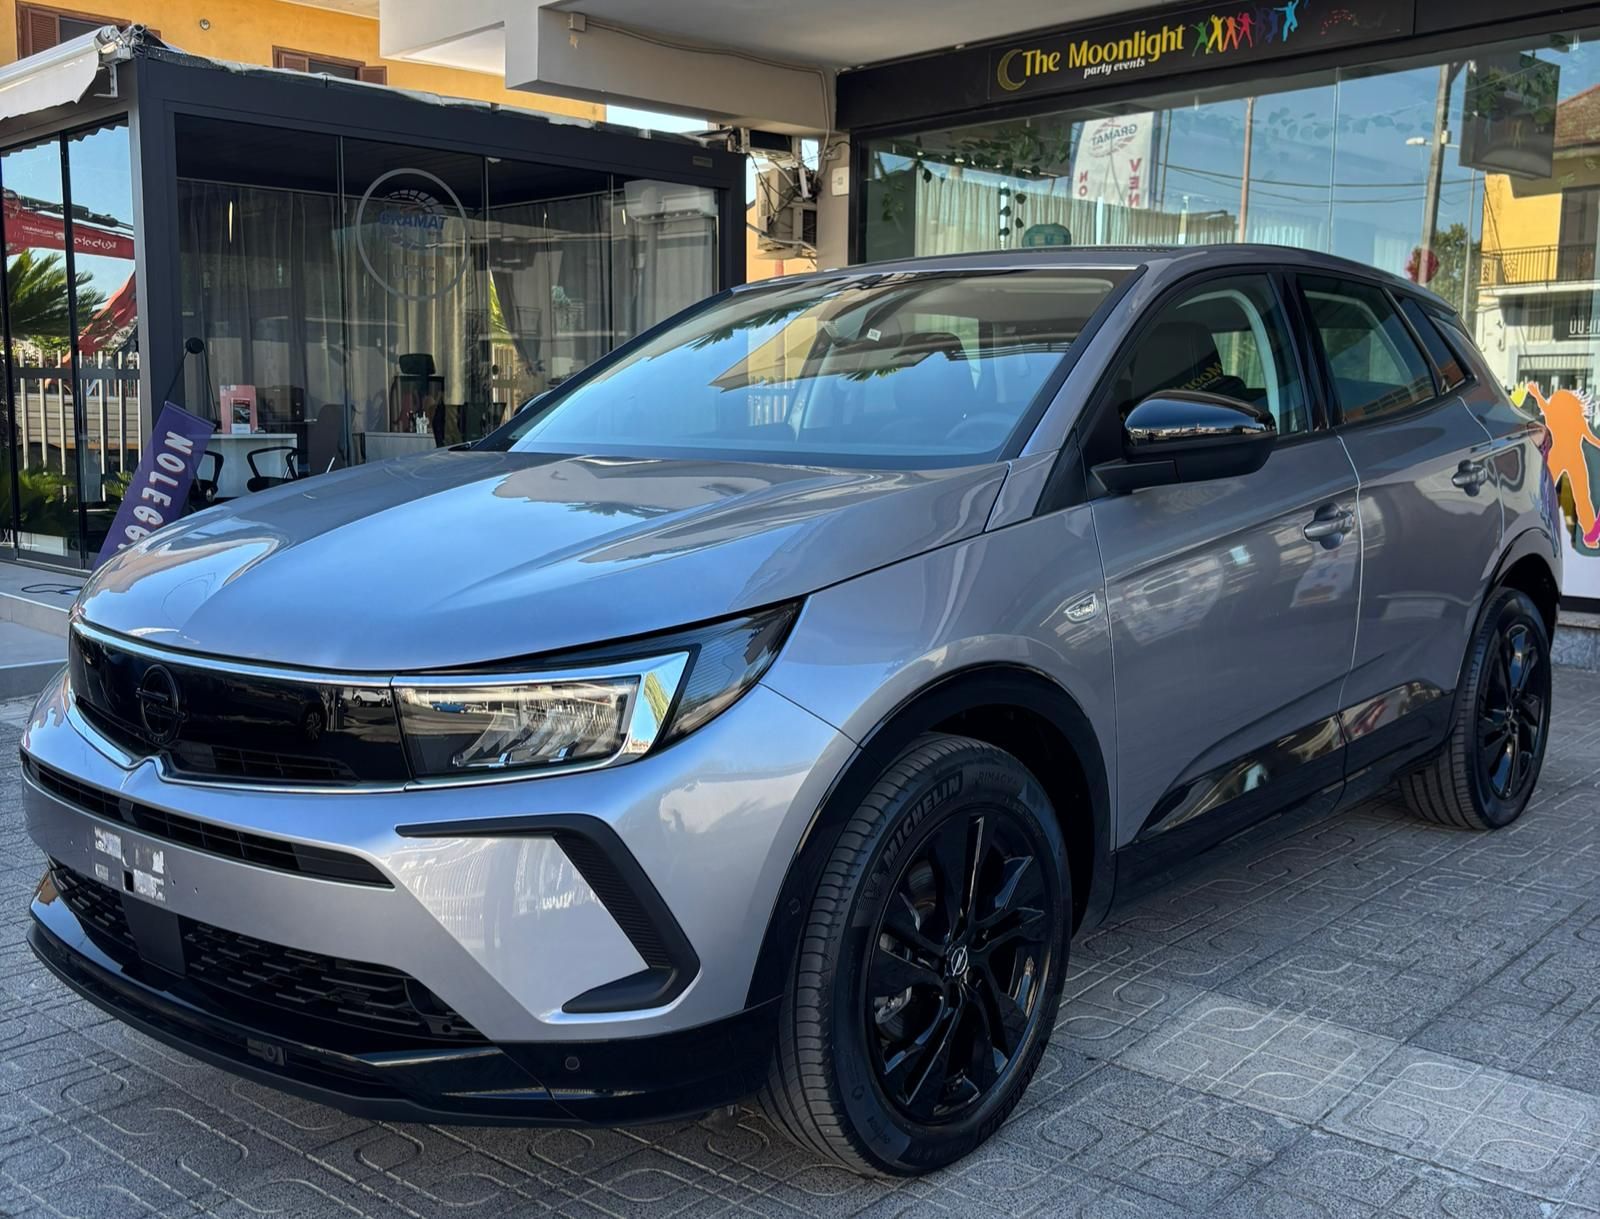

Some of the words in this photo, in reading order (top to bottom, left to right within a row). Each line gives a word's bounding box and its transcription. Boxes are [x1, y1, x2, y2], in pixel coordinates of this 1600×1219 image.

[1022, 49, 1060, 76] The
[1068, 24, 1186, 69] Moonlight
[1083, 64, 1112, 79] party
[1113, 58, 1146, 71] events
[882, 775, 961, 869] MICHELIN
